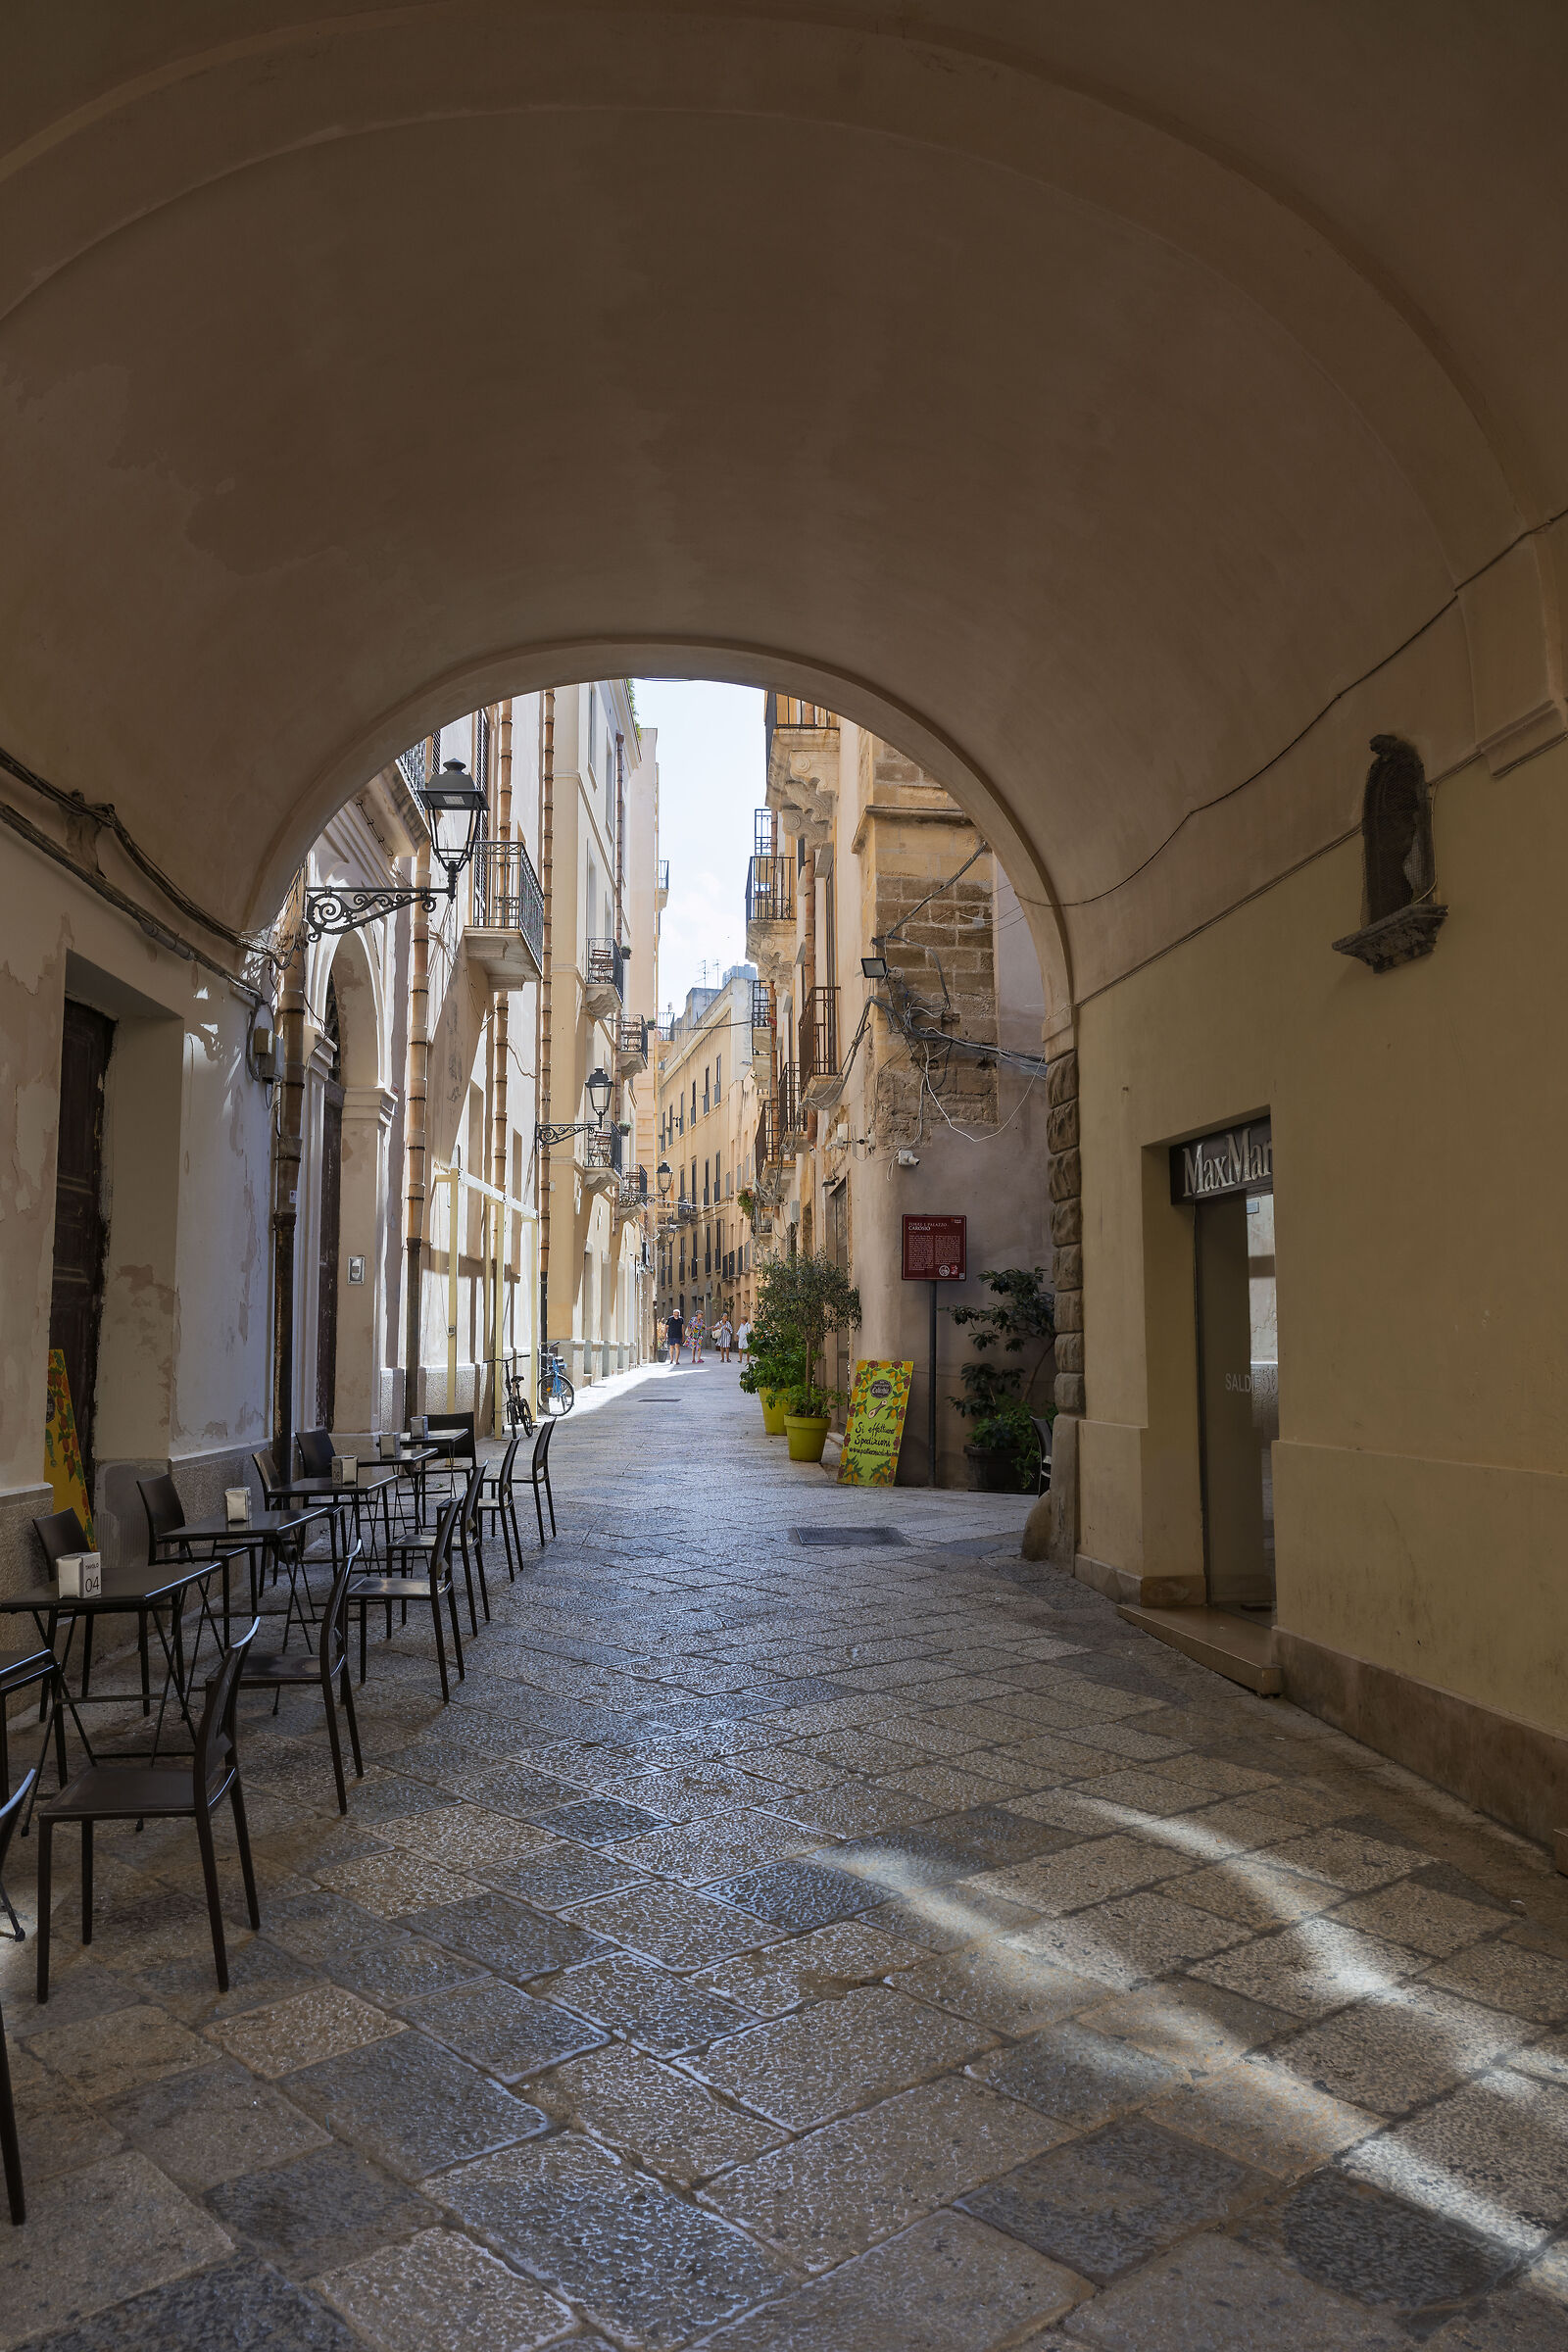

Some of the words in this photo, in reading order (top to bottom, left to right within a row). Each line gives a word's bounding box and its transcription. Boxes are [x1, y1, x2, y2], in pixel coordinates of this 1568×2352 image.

[855, 1421, 864, 1434] Si
[855, 1434, 890, 1447] Spedizioni
[85, 1576, 99, 1592] 04
